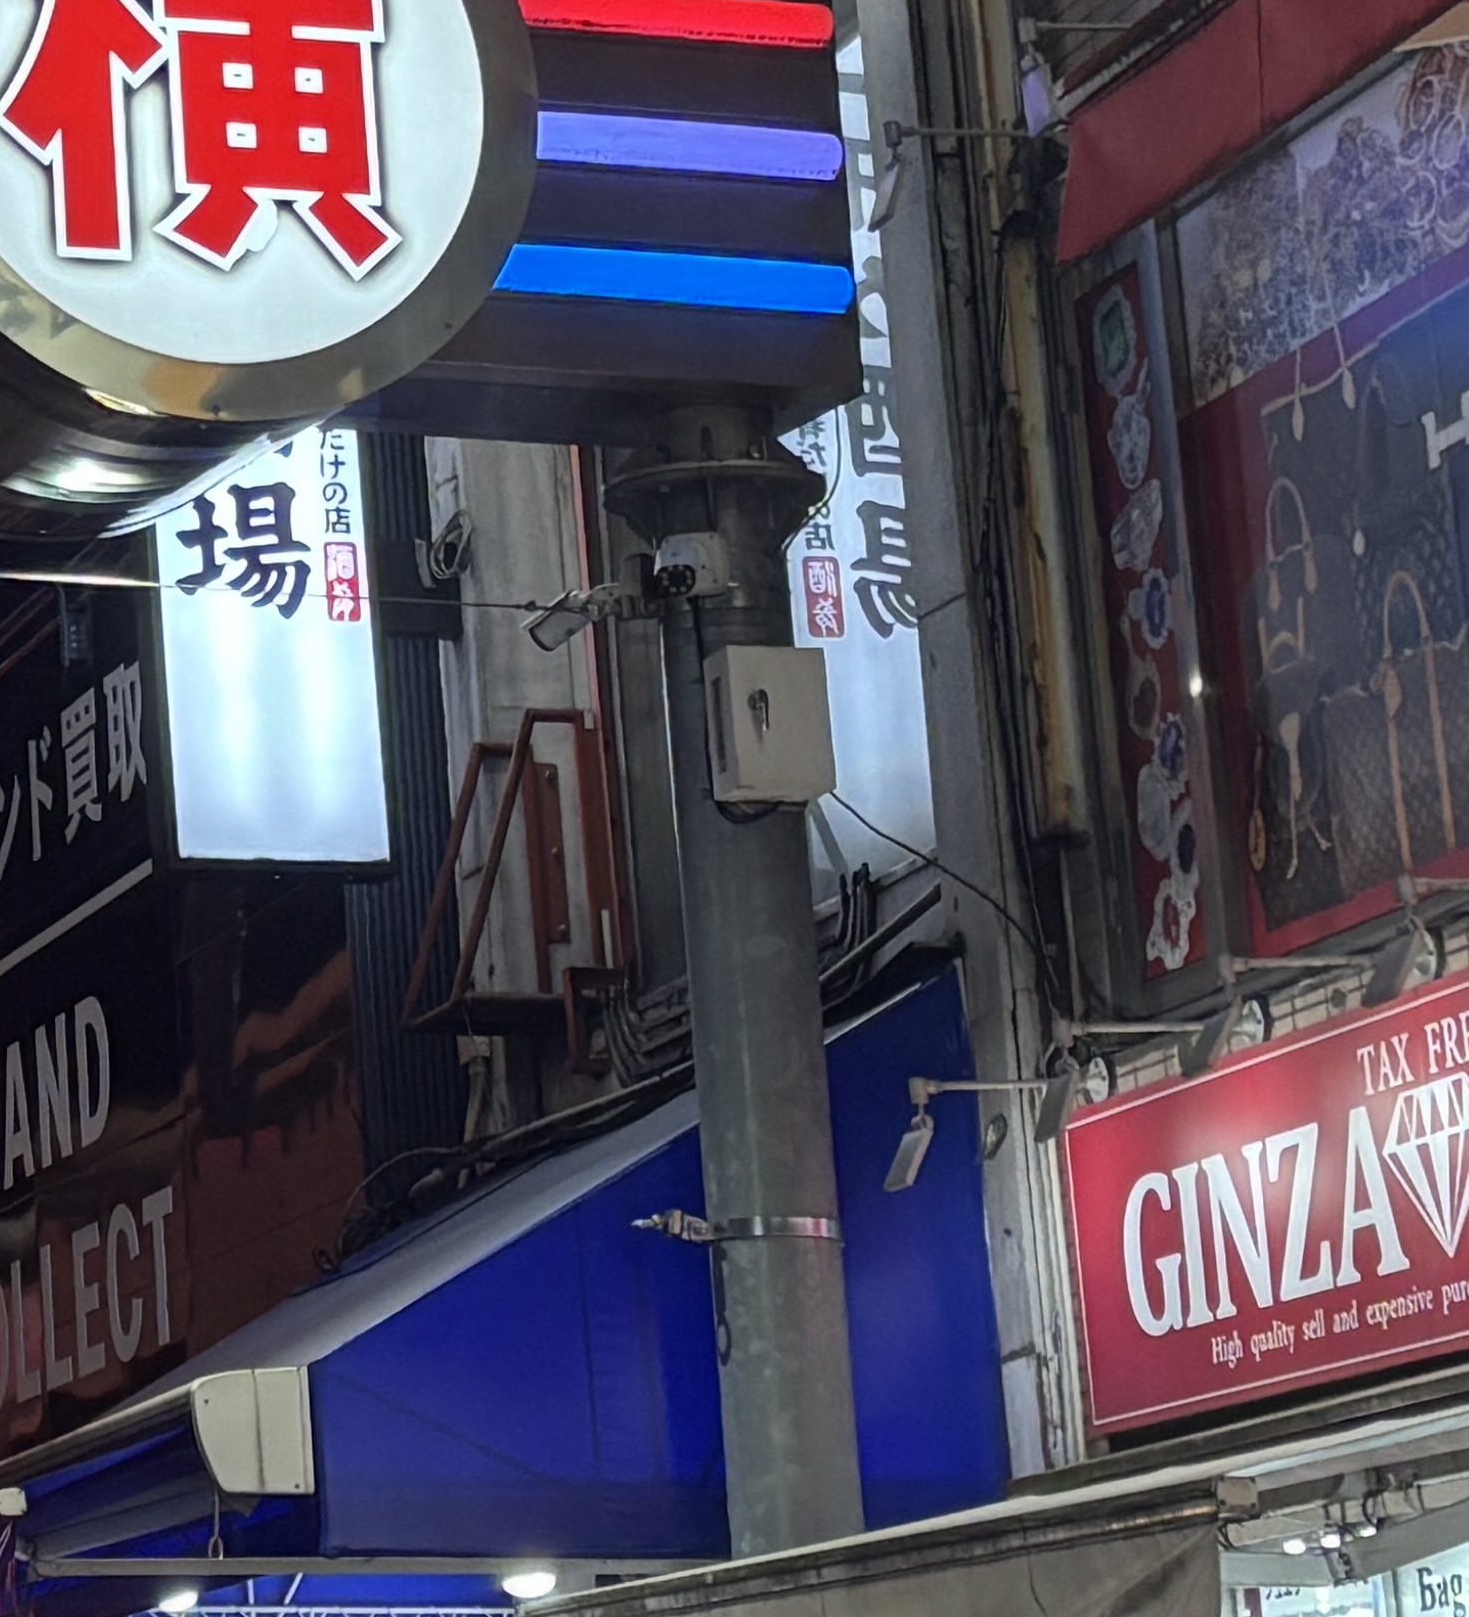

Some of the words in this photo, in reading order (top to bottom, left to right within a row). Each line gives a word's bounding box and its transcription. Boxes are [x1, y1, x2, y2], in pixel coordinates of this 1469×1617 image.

[174, 437, 312, 621] 場
[1356, 1032, 1415, 1096] TAX
[1123, 1105, 1411, 1338] GINZA
[1211, 1330, 1244, 1369] High
[1250, 1320, 1296, 1362] quality
[1302, 1309, 1325, 1342] sell
[1332, 1299, 1359, 1335] and
[1366, 1285, 1434, 1331] expensive
[1441, 1279, 1469, 1316] pur
